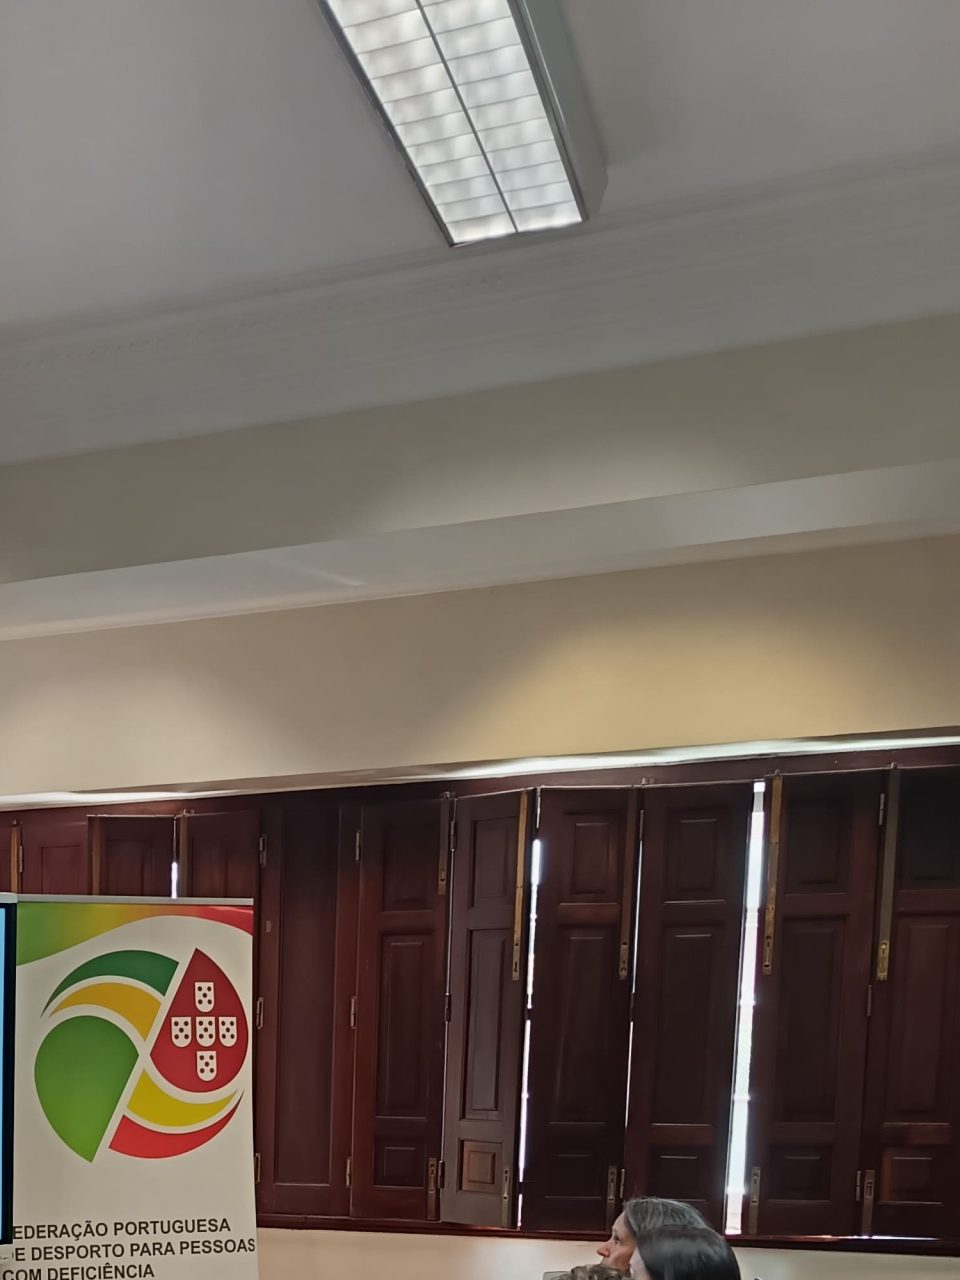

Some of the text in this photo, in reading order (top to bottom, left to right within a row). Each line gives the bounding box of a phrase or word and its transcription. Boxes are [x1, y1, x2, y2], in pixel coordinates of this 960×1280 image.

[13, 1218, 231, 1241] EDERAÇÃO PORTUGUESA
[12, 1238, 255, 1262] E DESPORTO PARA PESSOAS
